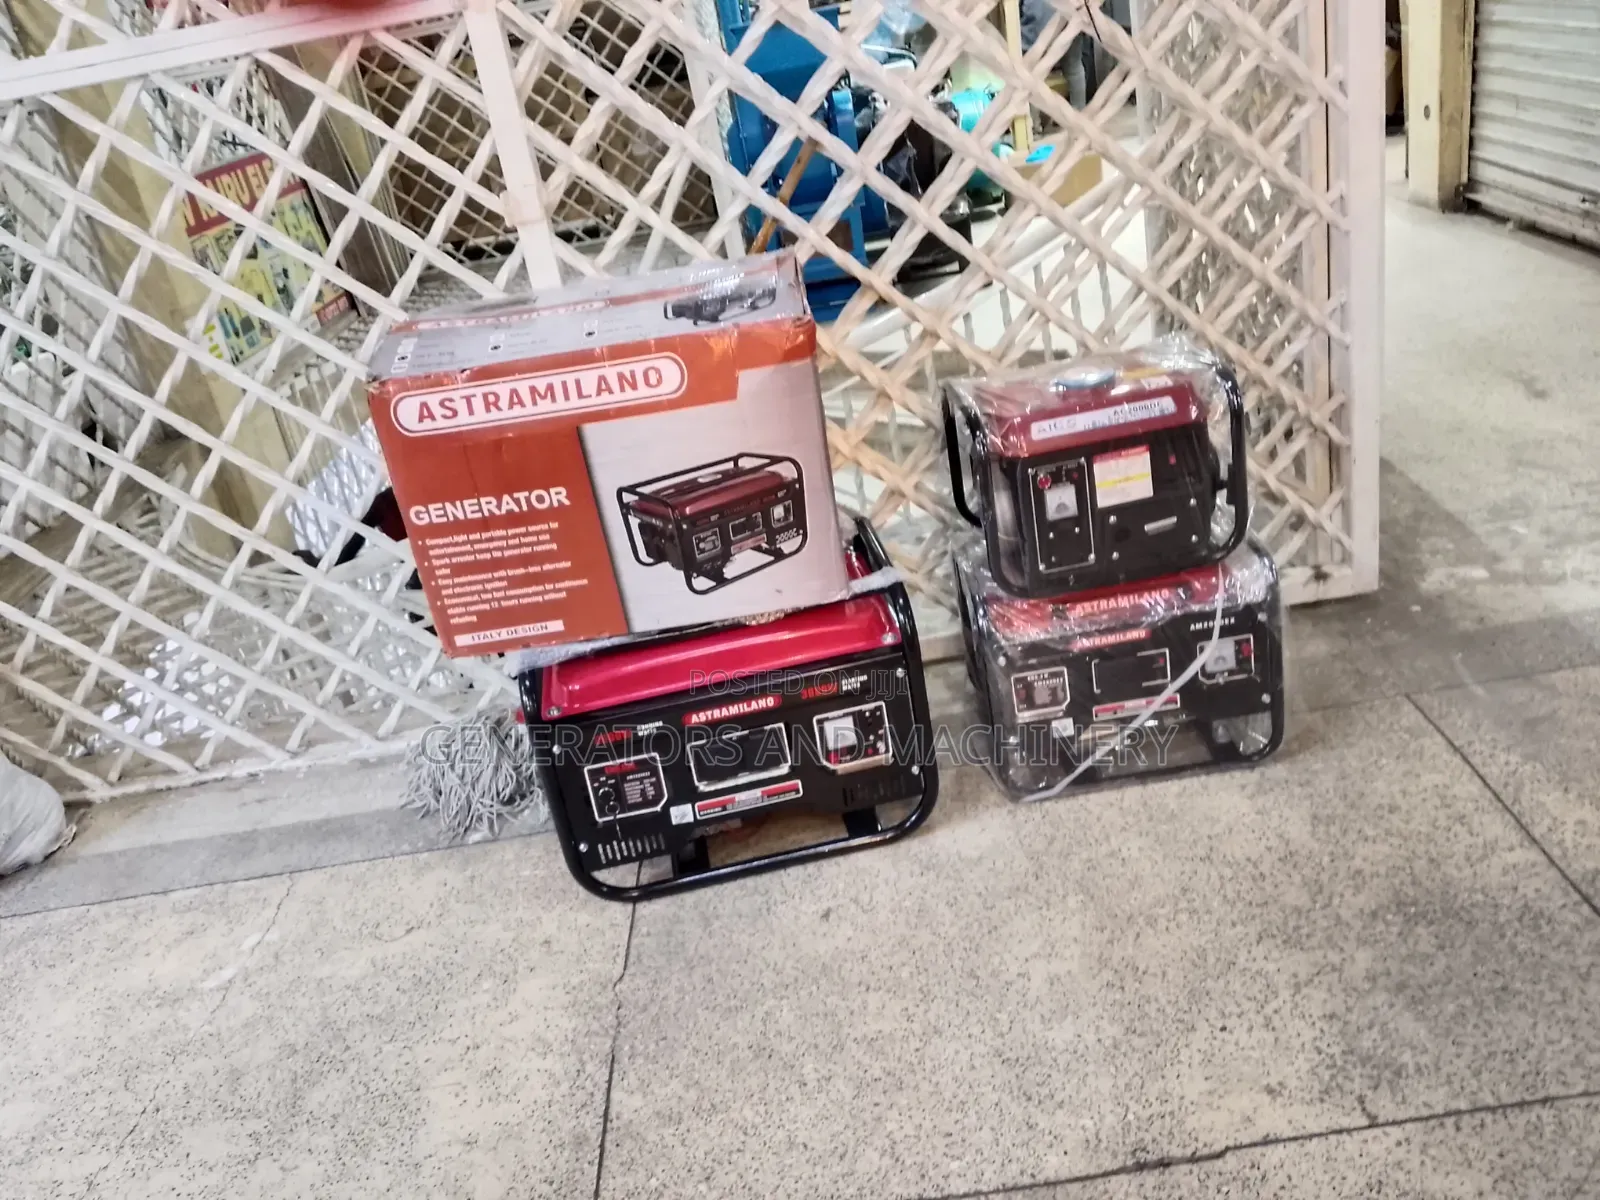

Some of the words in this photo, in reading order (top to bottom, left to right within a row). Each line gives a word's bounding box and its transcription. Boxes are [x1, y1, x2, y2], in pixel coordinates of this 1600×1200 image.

[417, 365, 664, 424] ASTRAMILANO
[409, 487, 571, 525] GENERATOR
[471, 630, 501, 642] ITALY
[506, 624, 549, 637] DESIGN
[691, 696, 774, 724] ASTRAMILANO
